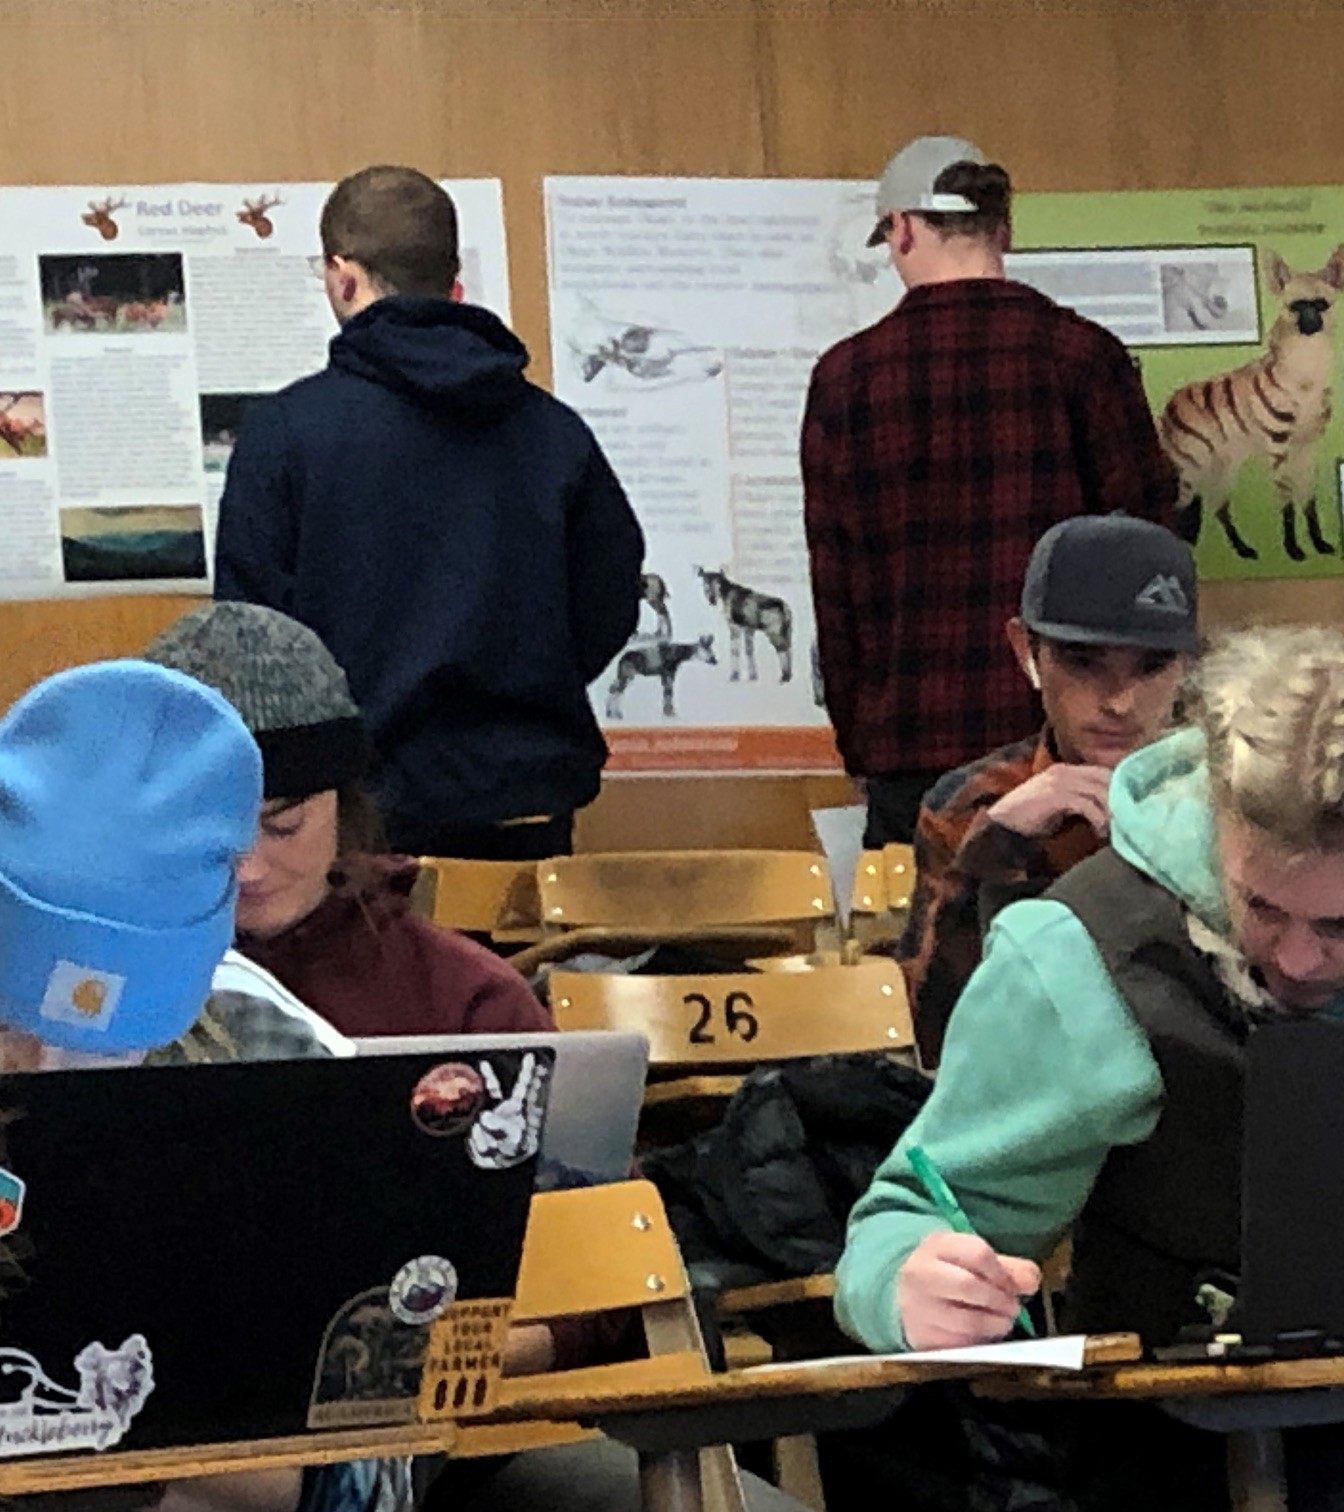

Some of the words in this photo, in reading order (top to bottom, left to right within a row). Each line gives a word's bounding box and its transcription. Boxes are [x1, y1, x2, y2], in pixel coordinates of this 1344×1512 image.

[136, 200, 172, 216] Red
[179, 199, 223, 216] Deer
[683, 990, 758, 1043] 26
